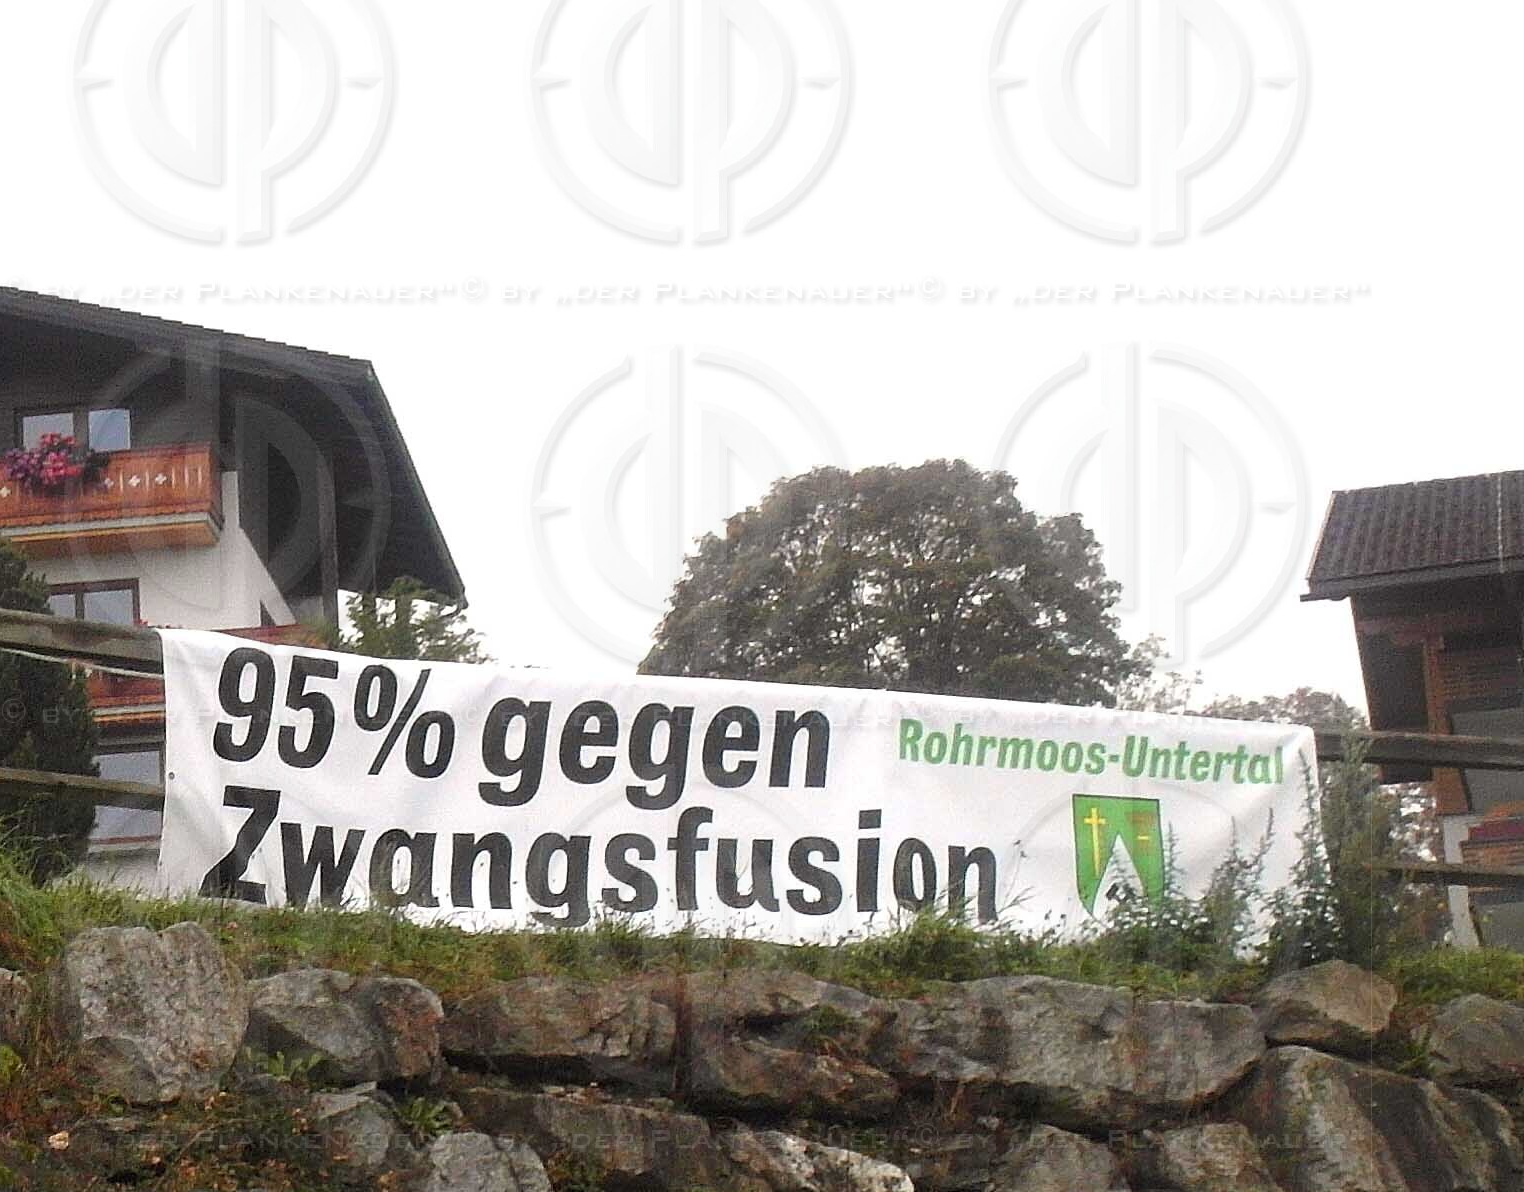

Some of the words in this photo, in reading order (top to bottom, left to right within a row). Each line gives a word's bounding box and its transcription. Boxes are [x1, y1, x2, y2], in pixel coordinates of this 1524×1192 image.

[478, 696, 830, 810] gegen
[899, 717, 1284, 784] Rohrmoos-Untertal
[198, 785, 999, 928] Zwangsfusion
